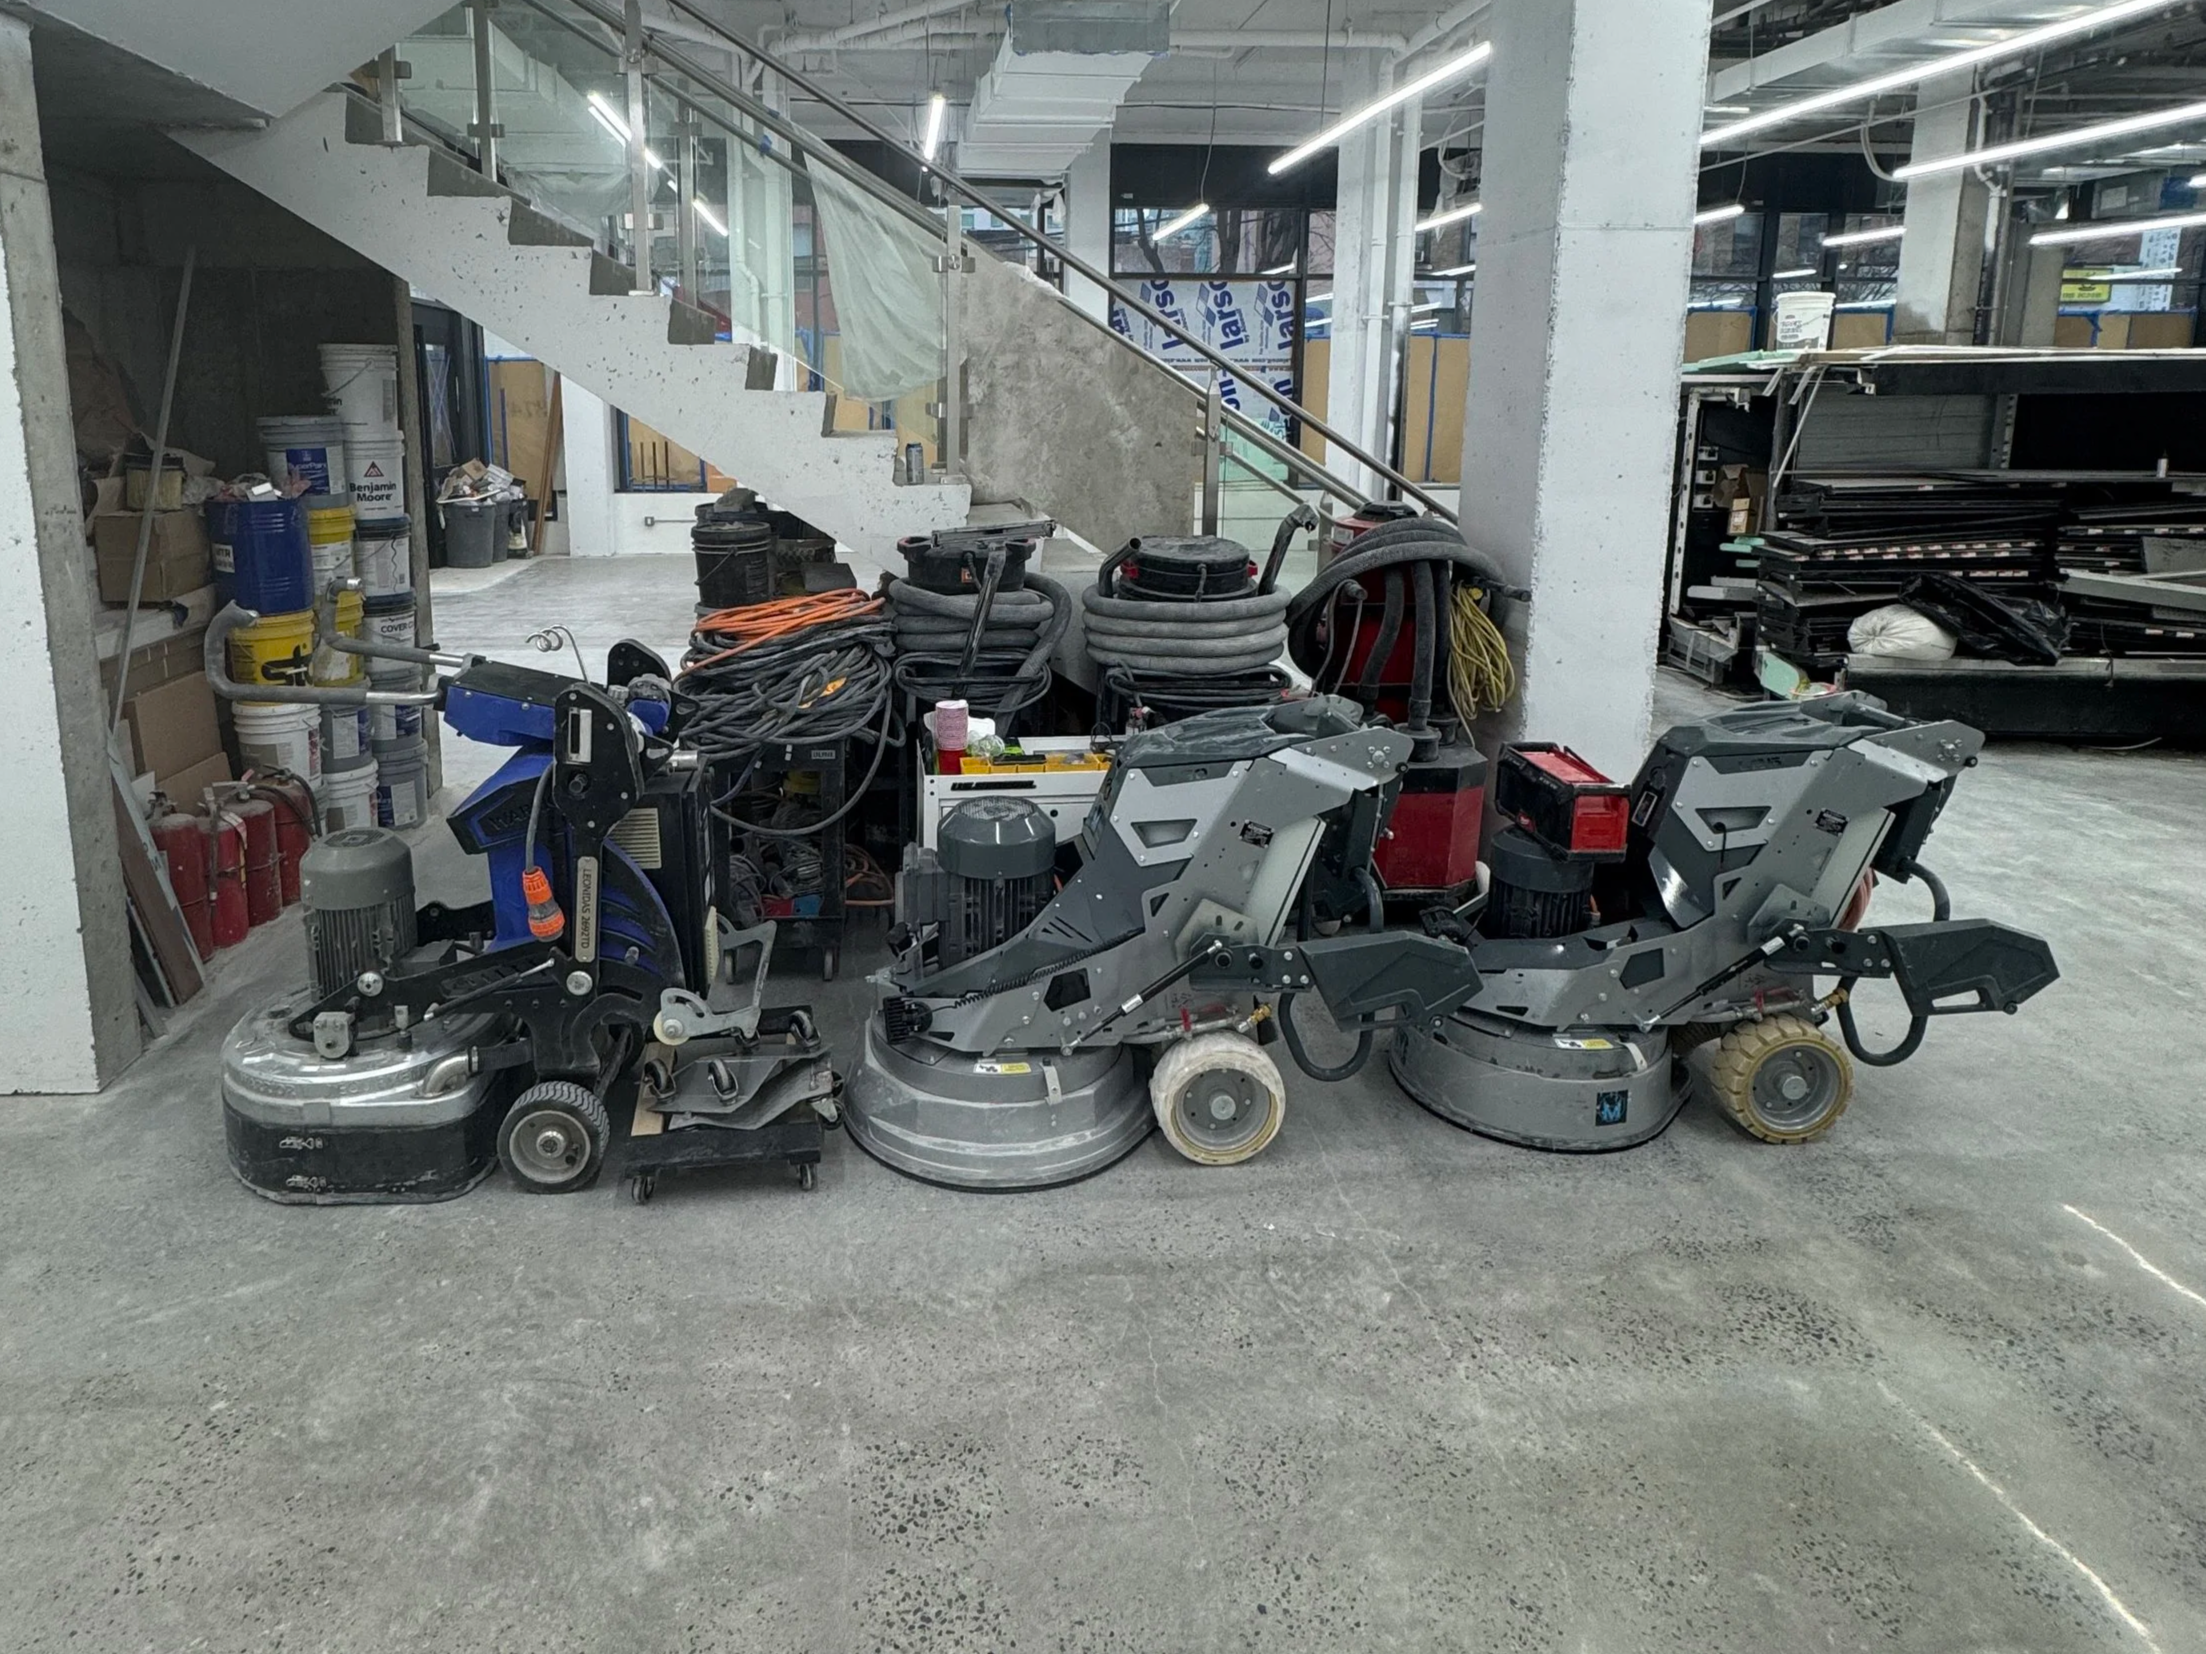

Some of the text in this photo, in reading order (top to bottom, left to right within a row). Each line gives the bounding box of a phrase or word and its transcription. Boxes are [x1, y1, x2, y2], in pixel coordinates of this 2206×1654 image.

[350, 481, 396, 492] Benjamin
[357, 493, 392, 502] Moore
[381, 623, 408, 633] COVER
[581, 868, 592, 914] LEONIDAS
